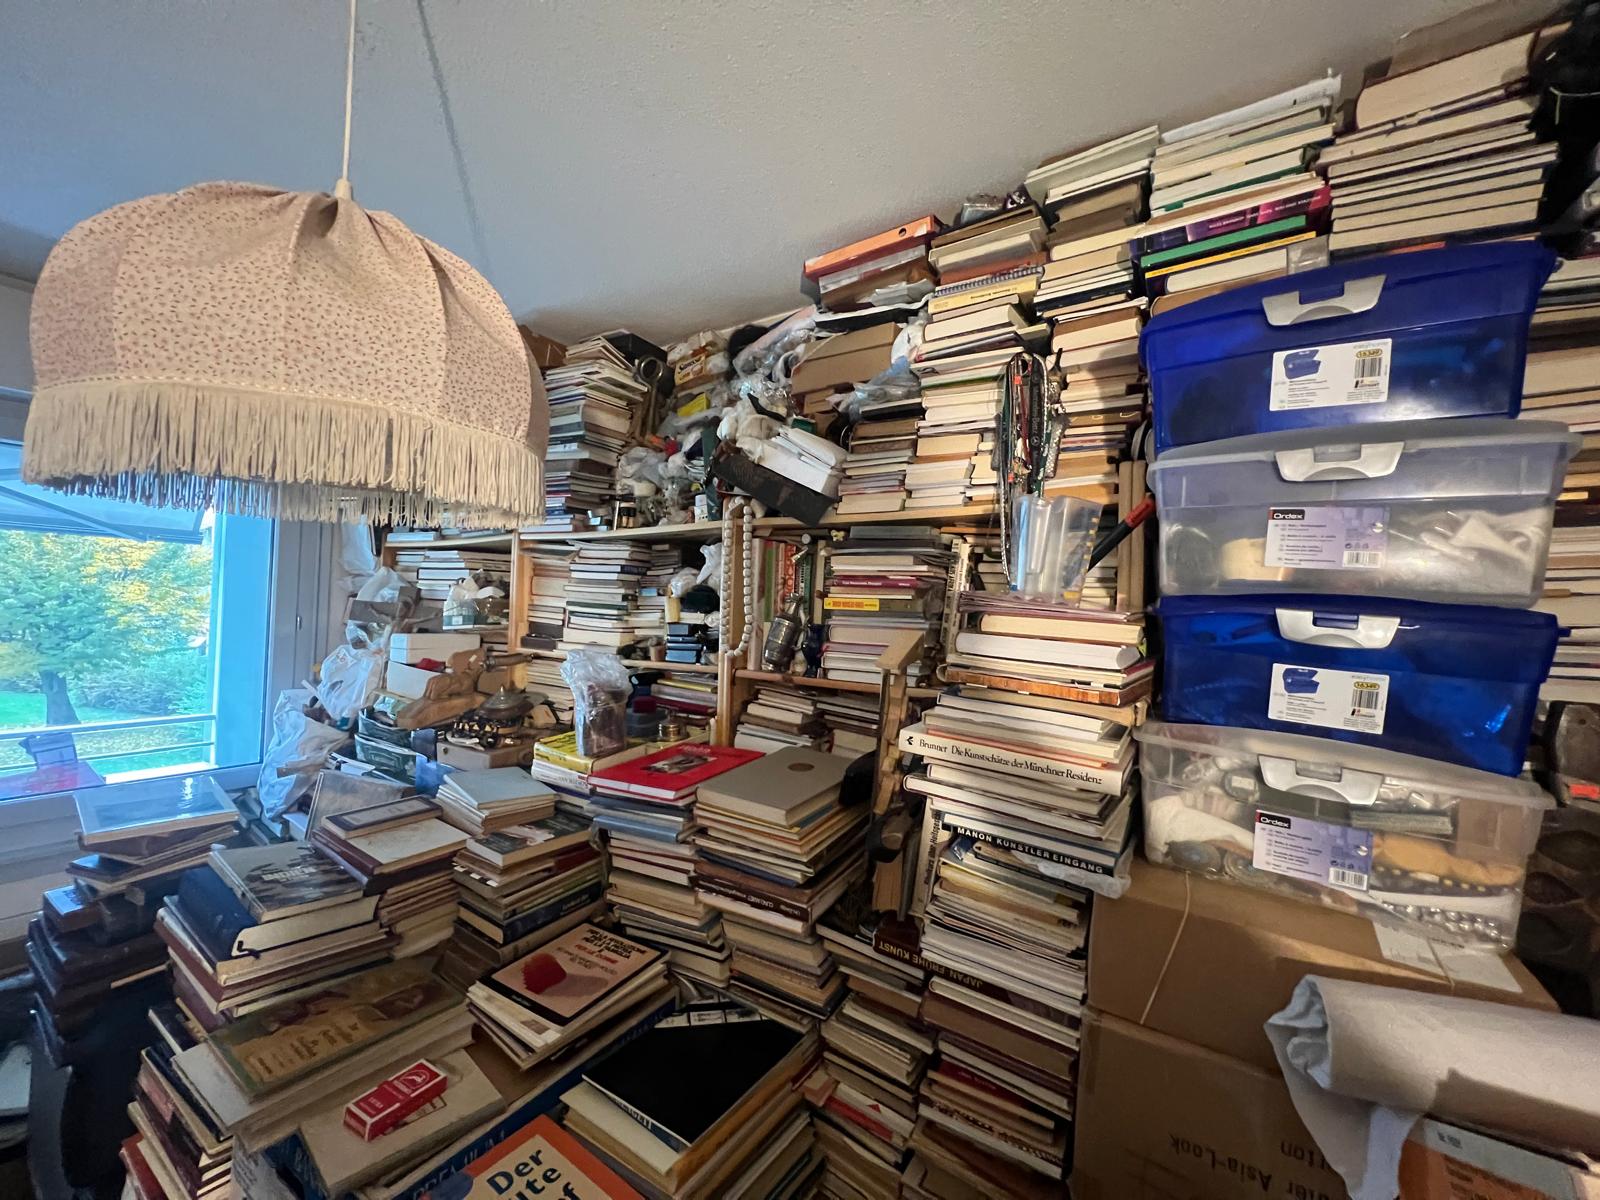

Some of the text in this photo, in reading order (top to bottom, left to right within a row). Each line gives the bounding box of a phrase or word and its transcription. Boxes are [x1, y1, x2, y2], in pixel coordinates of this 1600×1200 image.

[1273, 512, 1304, 520] Ordex
[919, 739, 1103, 784] Brunner Die Kunstschätze der Münchner Residenz
[1260, 816, 1290, 828] Ordex
[957, 826, 993, 842] MANON
[1052, 854, 1104, 874] EINGANG
[879, 940, 910, 960] KUNST
[949, 969, 983, 988] JAPAN
[486, 1149, 543, 1196] Der
[1169, 1134, 1272, 1192] Asia-Look
[507, 1167, 562, 1200] lte
